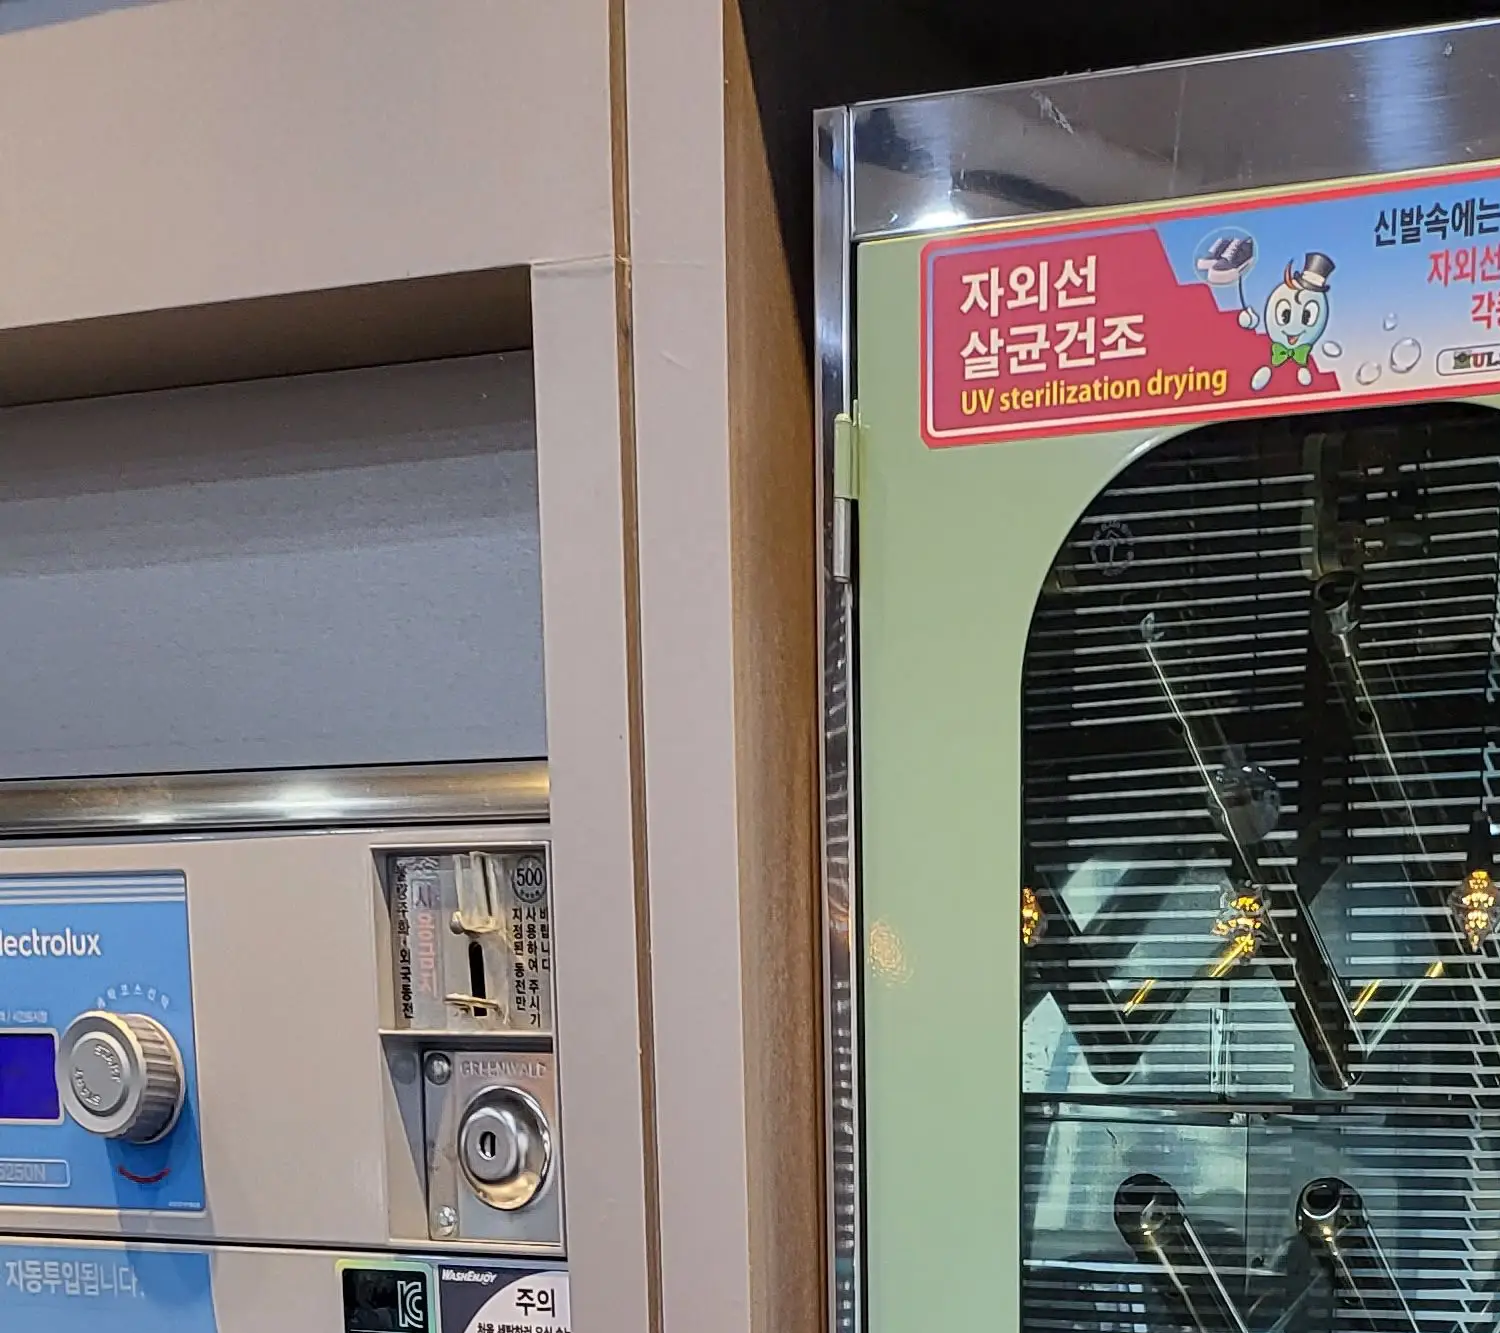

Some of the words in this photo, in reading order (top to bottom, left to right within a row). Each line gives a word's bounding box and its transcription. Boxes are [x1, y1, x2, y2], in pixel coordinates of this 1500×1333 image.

[960, 255, 1097, 317] 자외선
[960, 314, 1146, 380] 살균건조
[961, 389, 994, 415] UV
[1000, 376, 1140, 412] sterilization
[1147, 366, 1227, 401] drying
[6, 1260, 145, 1297] 자동투입됩니다.
[516, 1288, 555, 1318] 주의
